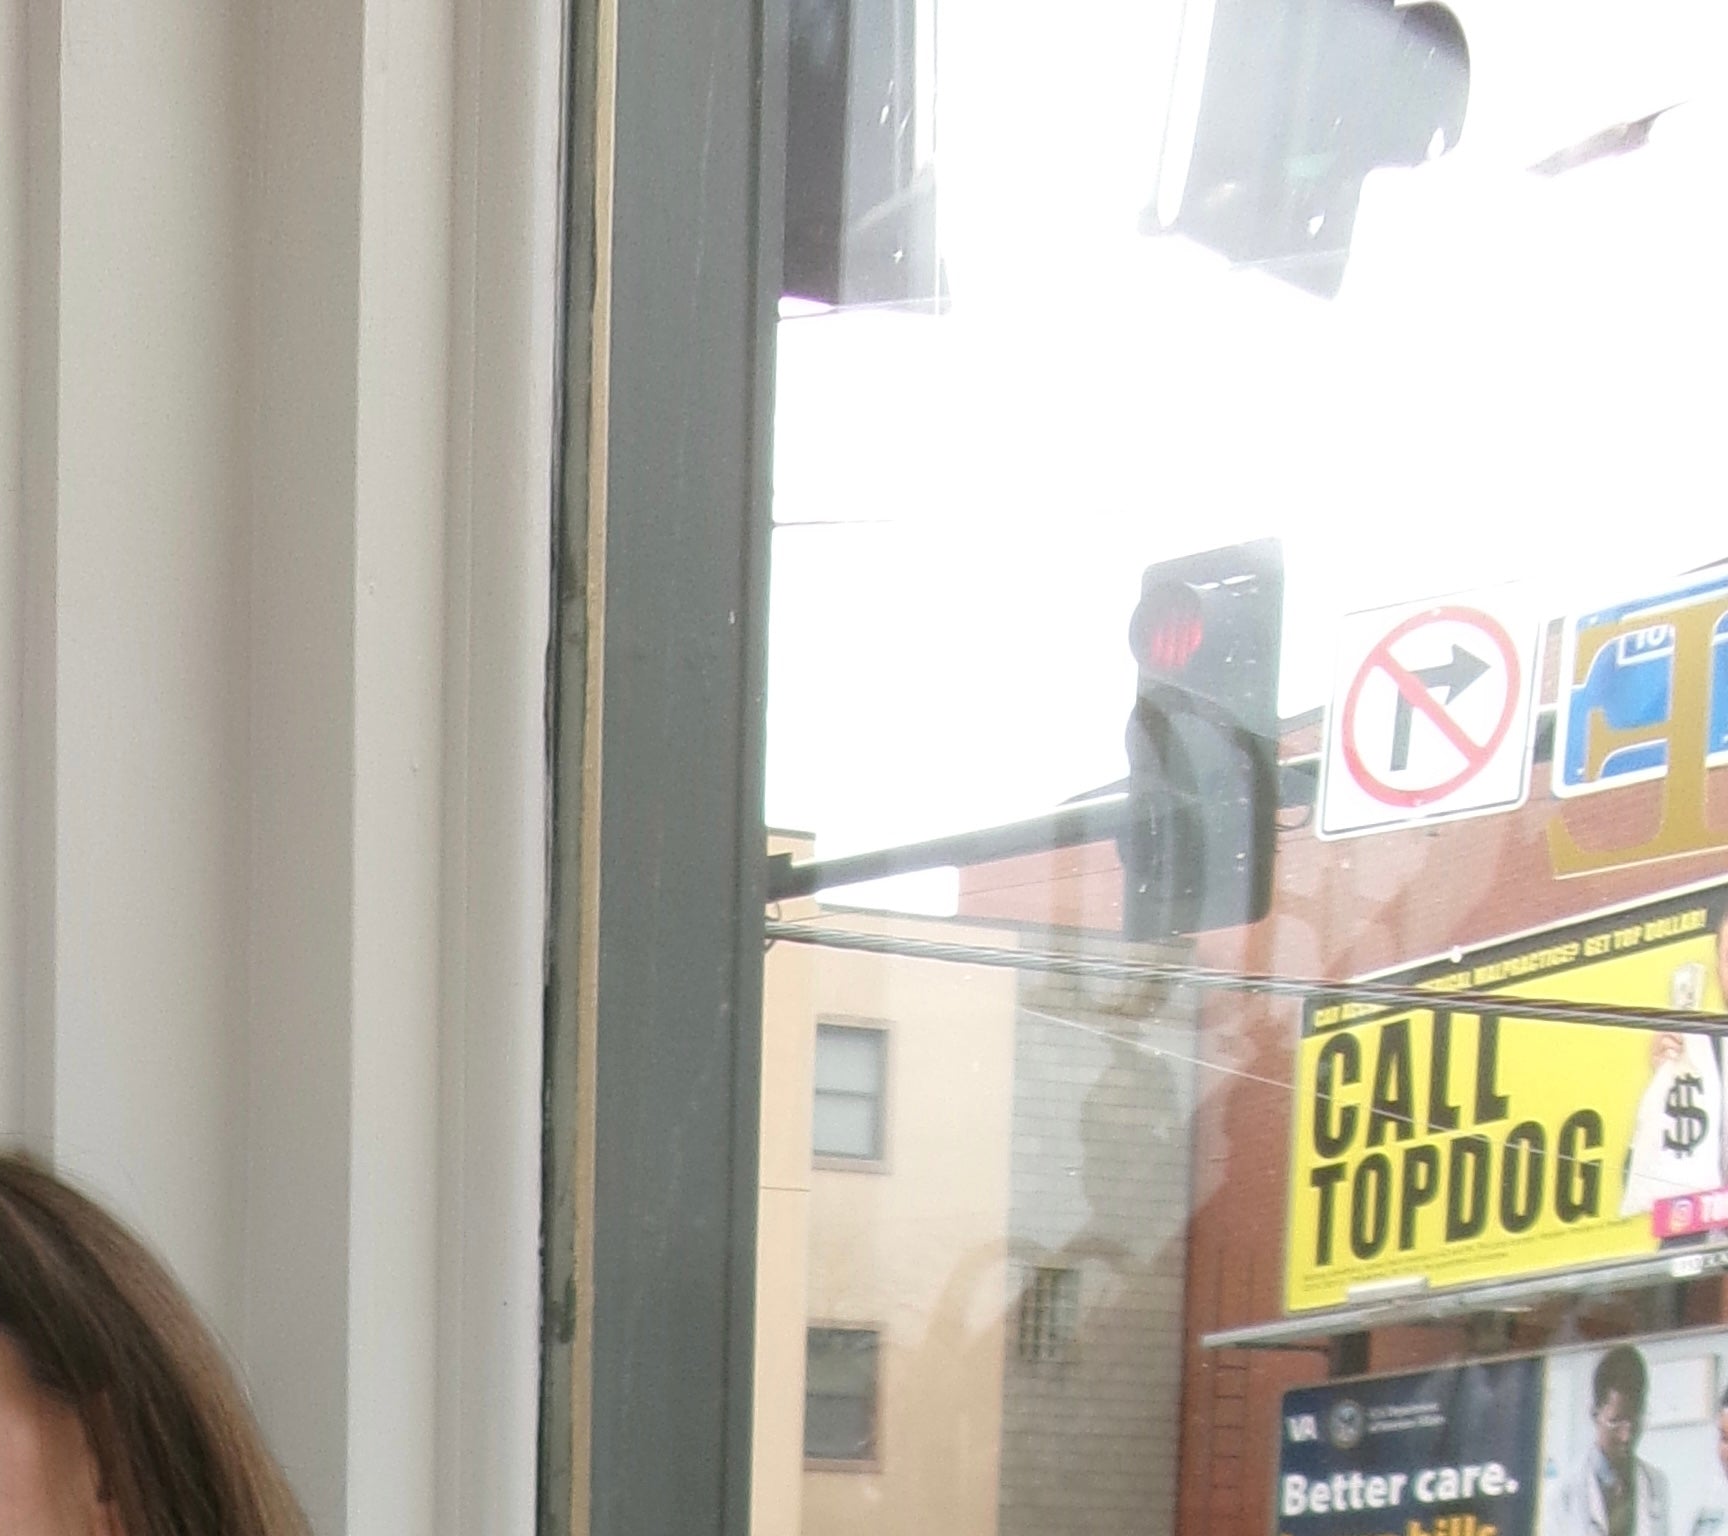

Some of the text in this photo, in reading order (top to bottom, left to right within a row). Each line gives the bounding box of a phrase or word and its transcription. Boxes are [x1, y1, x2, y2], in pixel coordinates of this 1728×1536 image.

[1312, 1009, 1510, 1158] CALL
[1309, 1108, 1604, 1267] TOPDOG
[1281, 1461, 1520, 1517] Better care.
